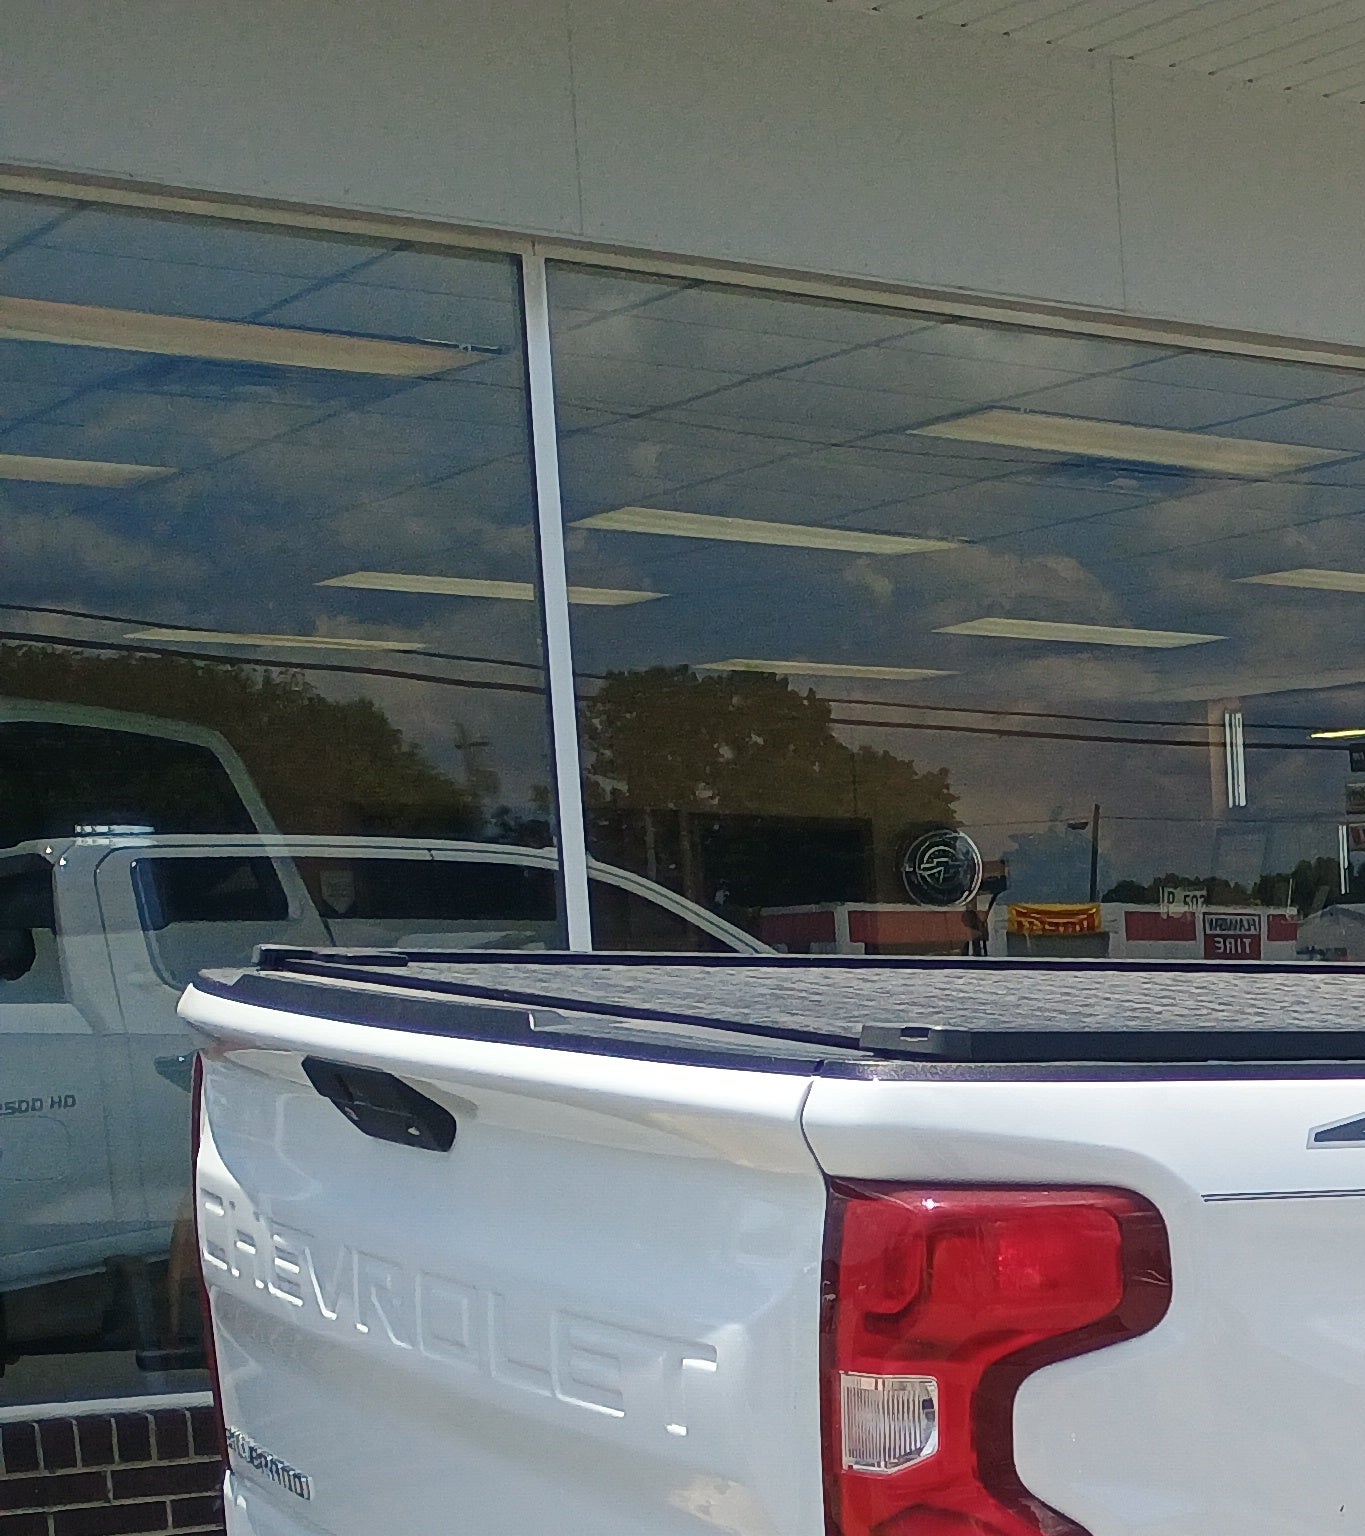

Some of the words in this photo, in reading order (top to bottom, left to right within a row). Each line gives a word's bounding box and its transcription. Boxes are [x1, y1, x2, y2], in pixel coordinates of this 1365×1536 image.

[0, 1097, 44, 1116] 500
[50, 1094, 77, 1110] HD
[198, 1187, 719, 1437] CHEVROLET
